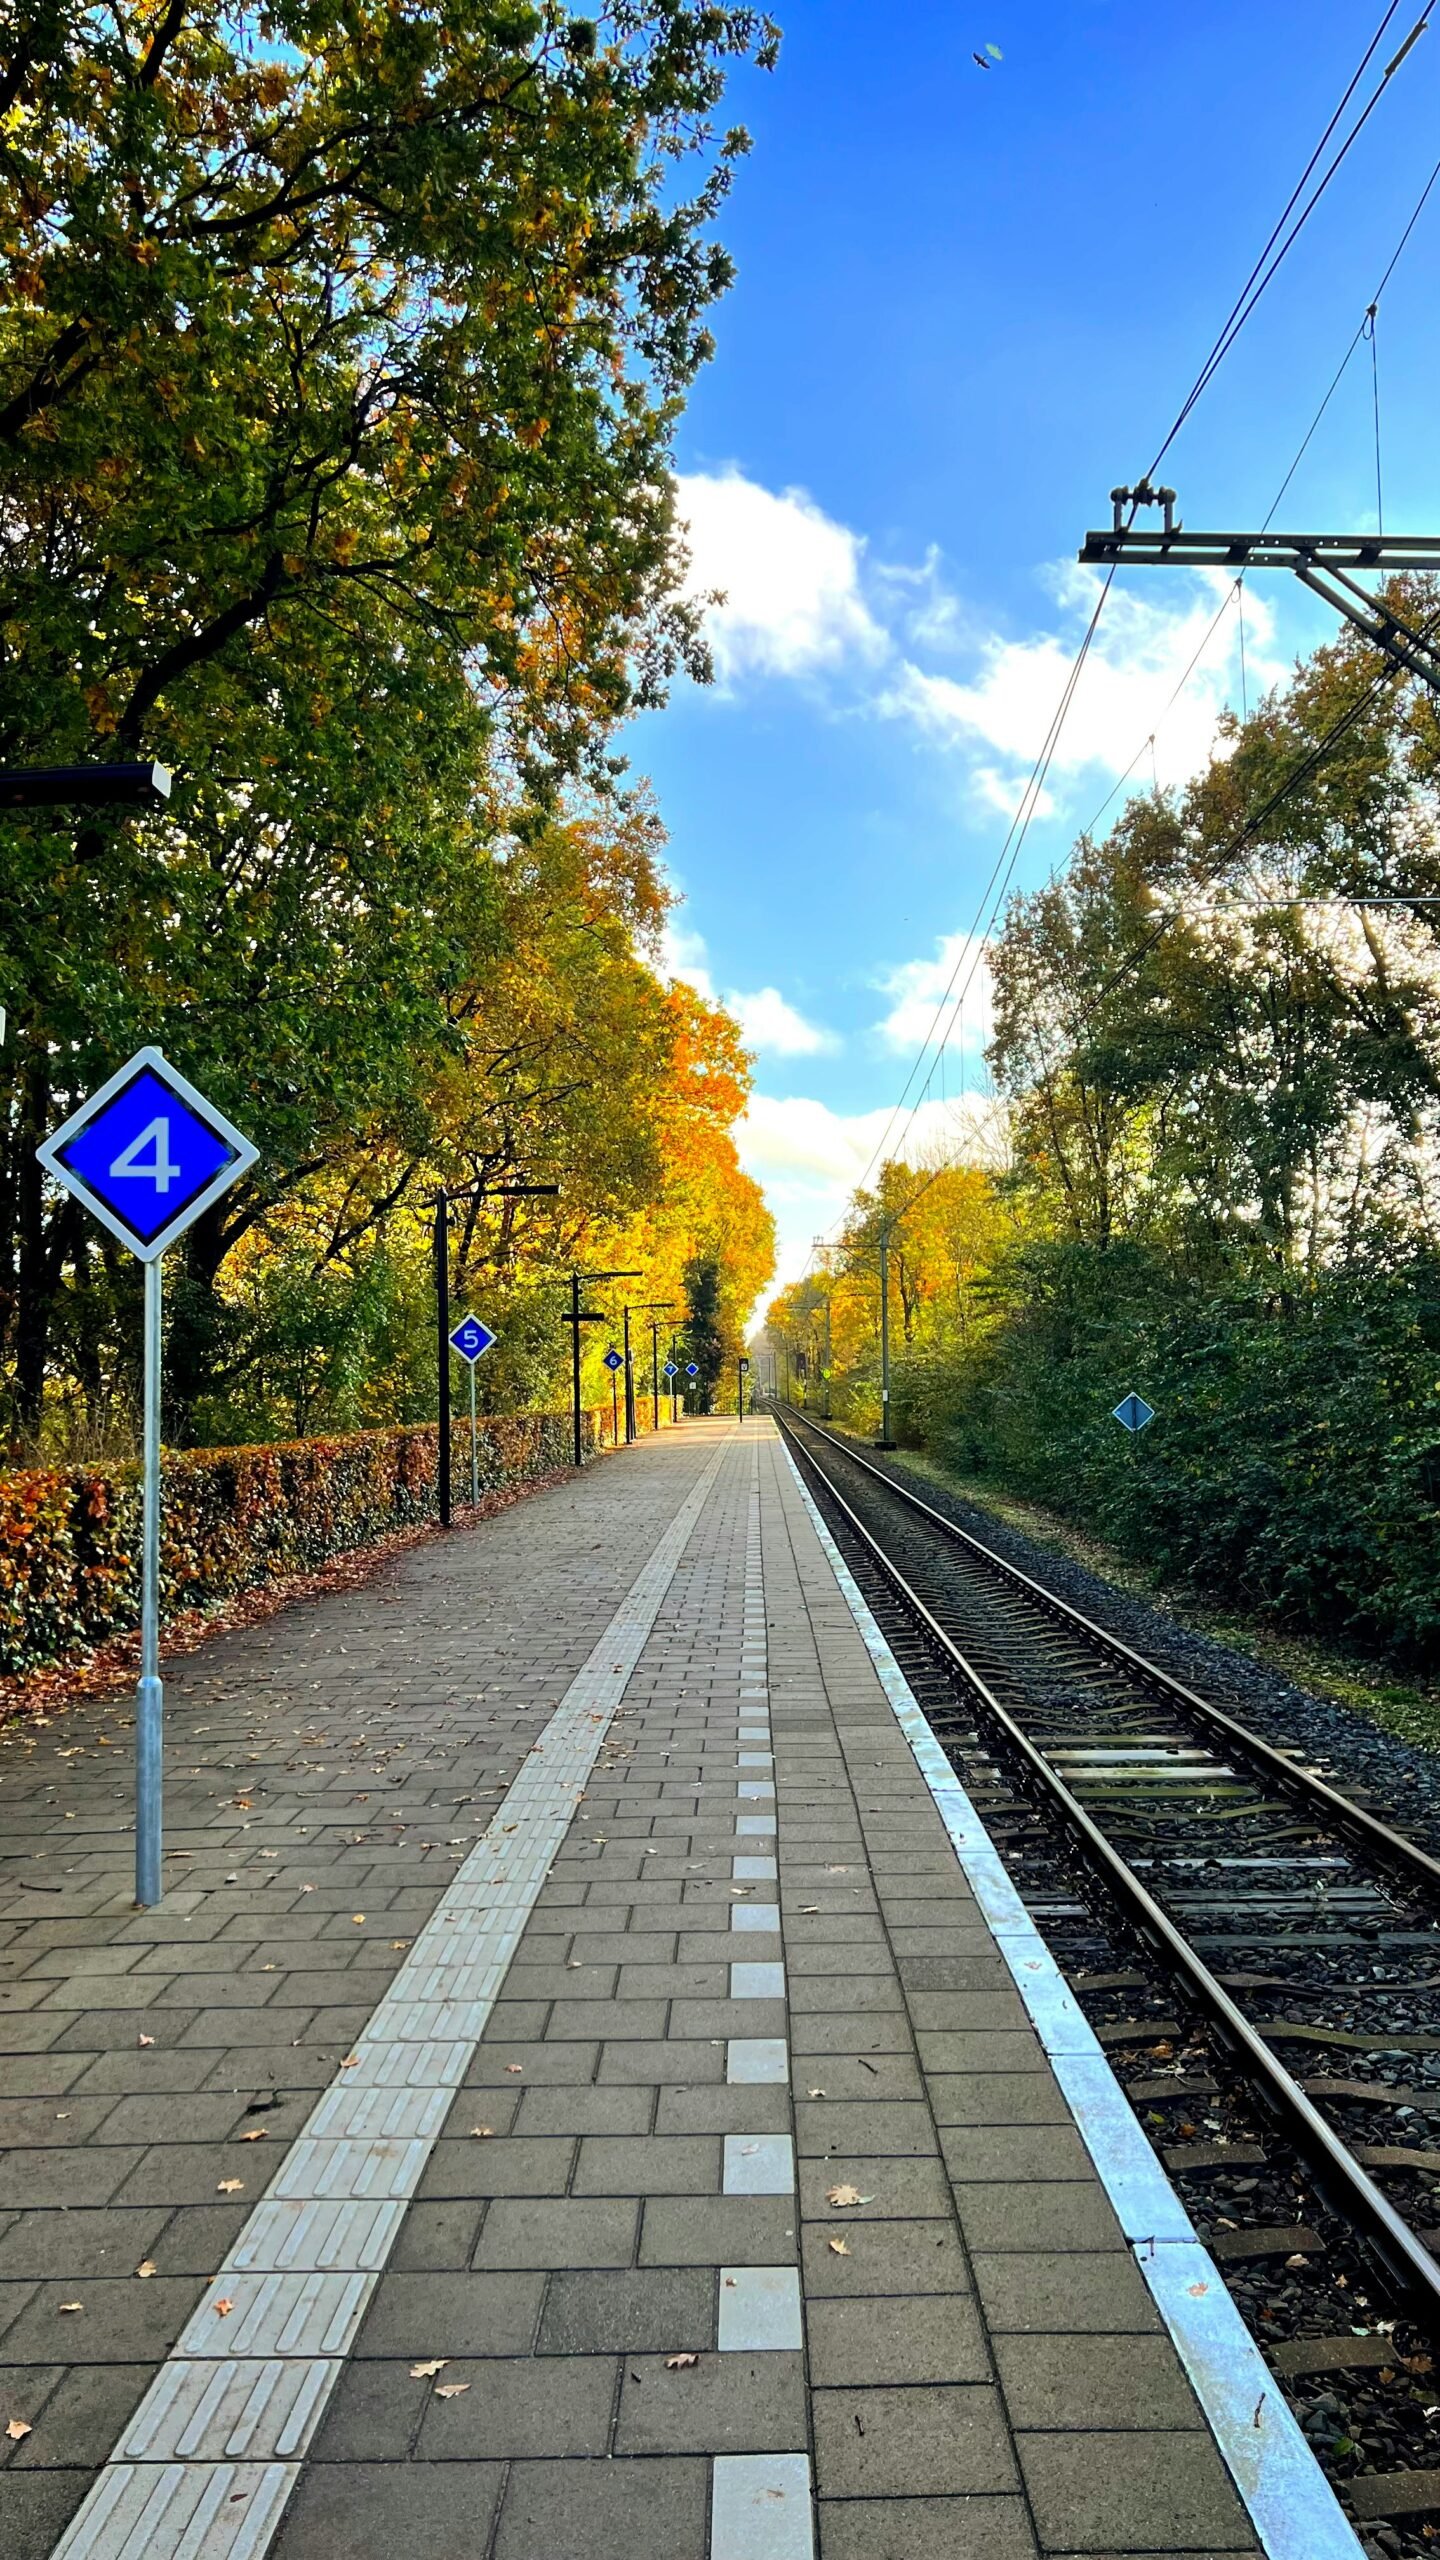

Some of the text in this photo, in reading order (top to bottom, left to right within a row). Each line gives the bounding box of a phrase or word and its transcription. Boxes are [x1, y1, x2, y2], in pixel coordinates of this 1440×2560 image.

[109, 1117, 181, 1193] 4
[464, 1330, 478, 1348] 5
[610, 1355, 617, 1365] 6
